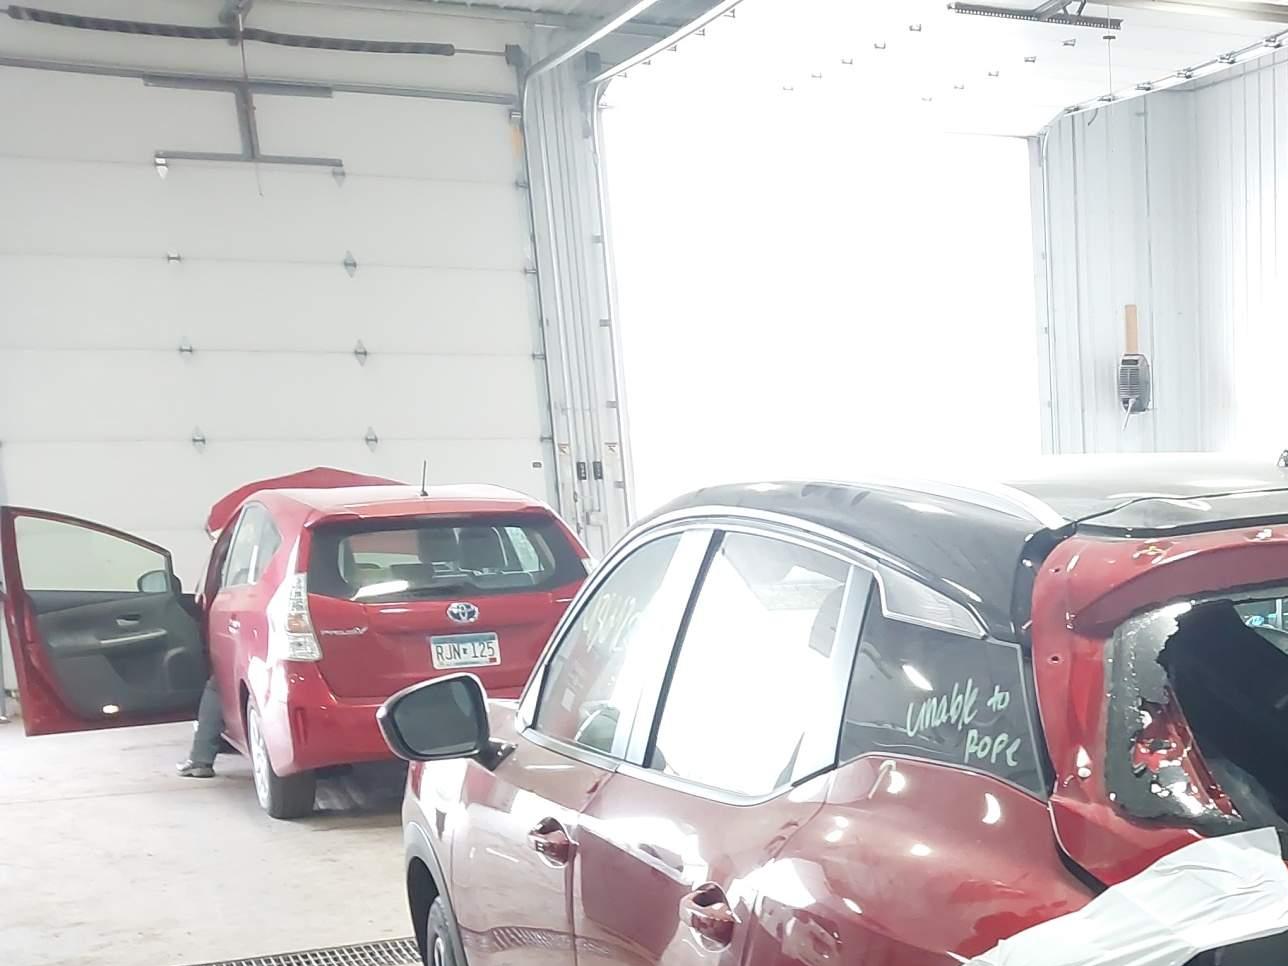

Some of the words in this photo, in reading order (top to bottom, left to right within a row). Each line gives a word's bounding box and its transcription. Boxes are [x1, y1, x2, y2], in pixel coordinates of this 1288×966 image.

[435, 643, 462, 662] RJN
[471, 641, 496, 659] 125
[987, 685, 1010, 712] to
